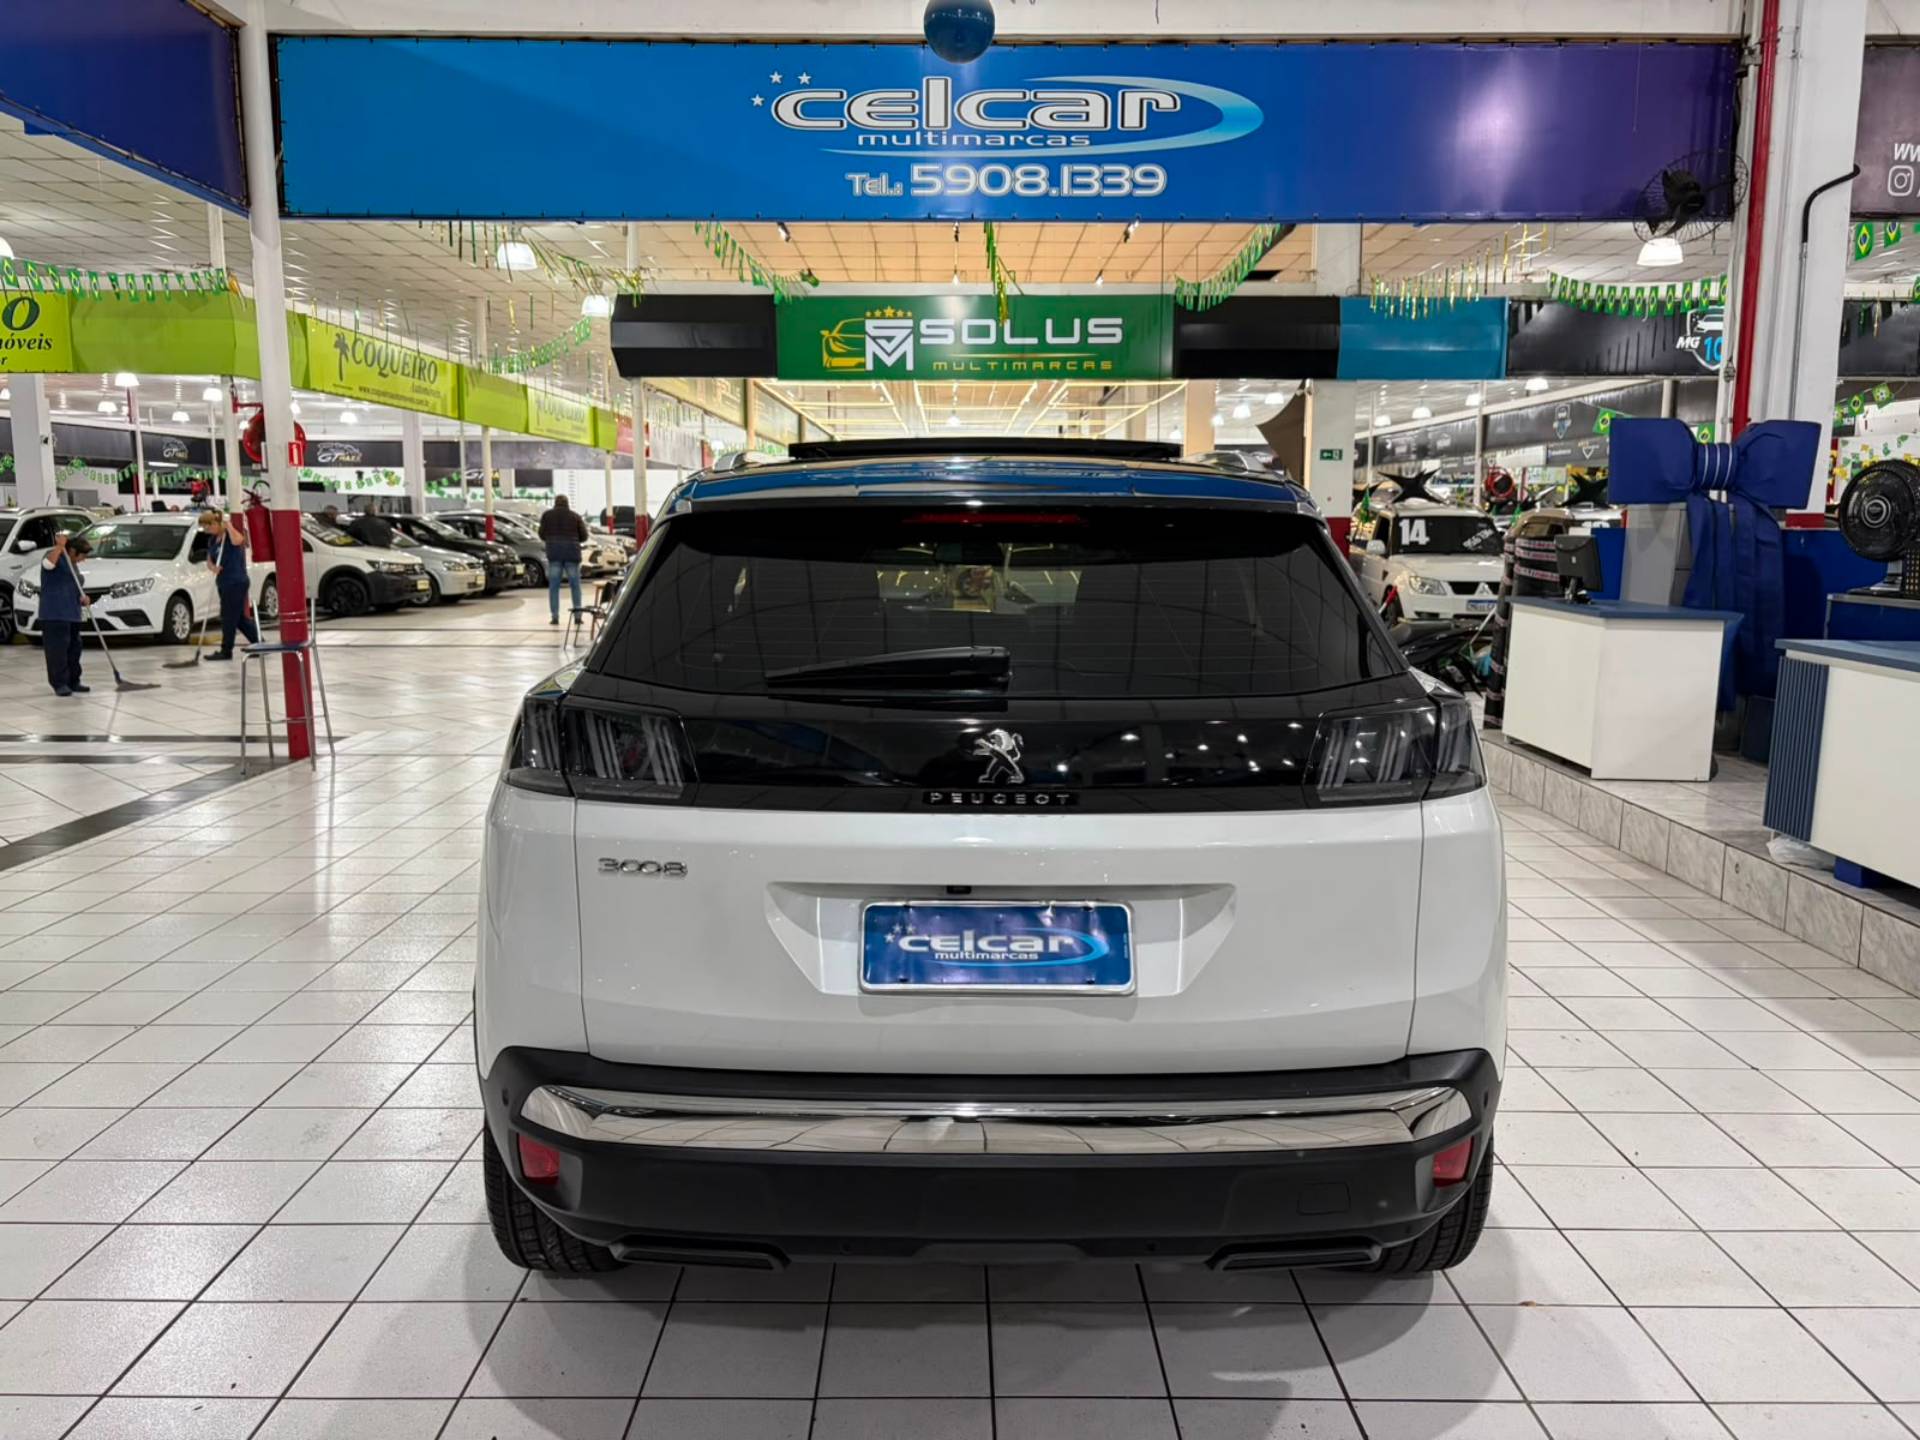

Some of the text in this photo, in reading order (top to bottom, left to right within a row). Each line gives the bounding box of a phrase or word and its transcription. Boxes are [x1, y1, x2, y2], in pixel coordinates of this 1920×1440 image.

[771, 76, 1181, 131] celcar
[857, 130, 1090, 146] multimarcas
[910, 163, 1167, 197] 5908.1339
[919, 317, 1123, 344] SOLUS
[0, 333, 52, 350] óveis
[1676, 336, 1701, 349] MG
[352, 338, 438, 384] COQUEIRO
[932, 361, 1113, 371] MULTIMARCAS
[1398, 518, 1430, 545] 14
[930, 793, 1069, 804] PEUGEOT
[598, 857, 688, 876] 3008
[899, 930, 1074, 952] celcar
[934, 950, 1039, 960] multimarcas
